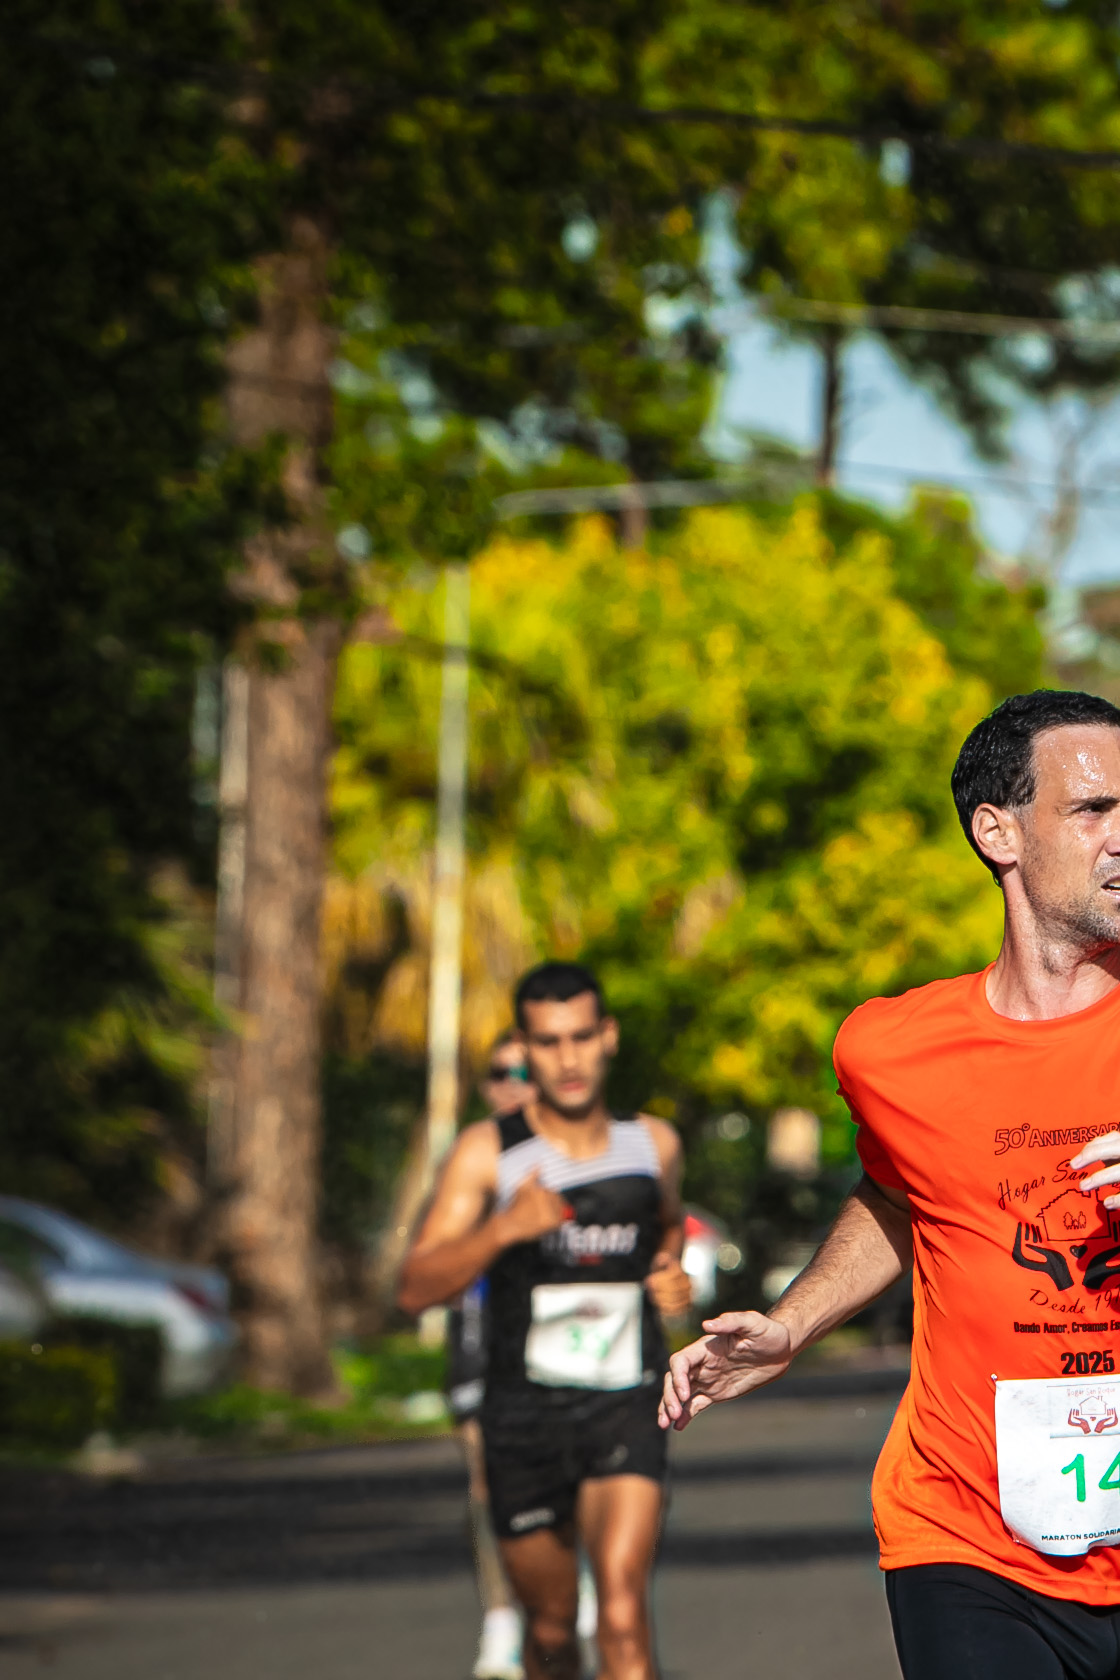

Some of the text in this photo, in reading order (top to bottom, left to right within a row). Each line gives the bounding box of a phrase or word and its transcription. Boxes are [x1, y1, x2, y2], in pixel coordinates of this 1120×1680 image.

[998, 1159, 1088, 1210] Hogar San
[1029, 1289, 1086, 1313] Desde
[1014, 1321, 1041, 1334] Dando
[1072, 1321, 1108, 1333] Creamos
[1060, 1349, 1116, 1375] 2025
[1083, 1528, 1120, 1540] SOLIDARIA
